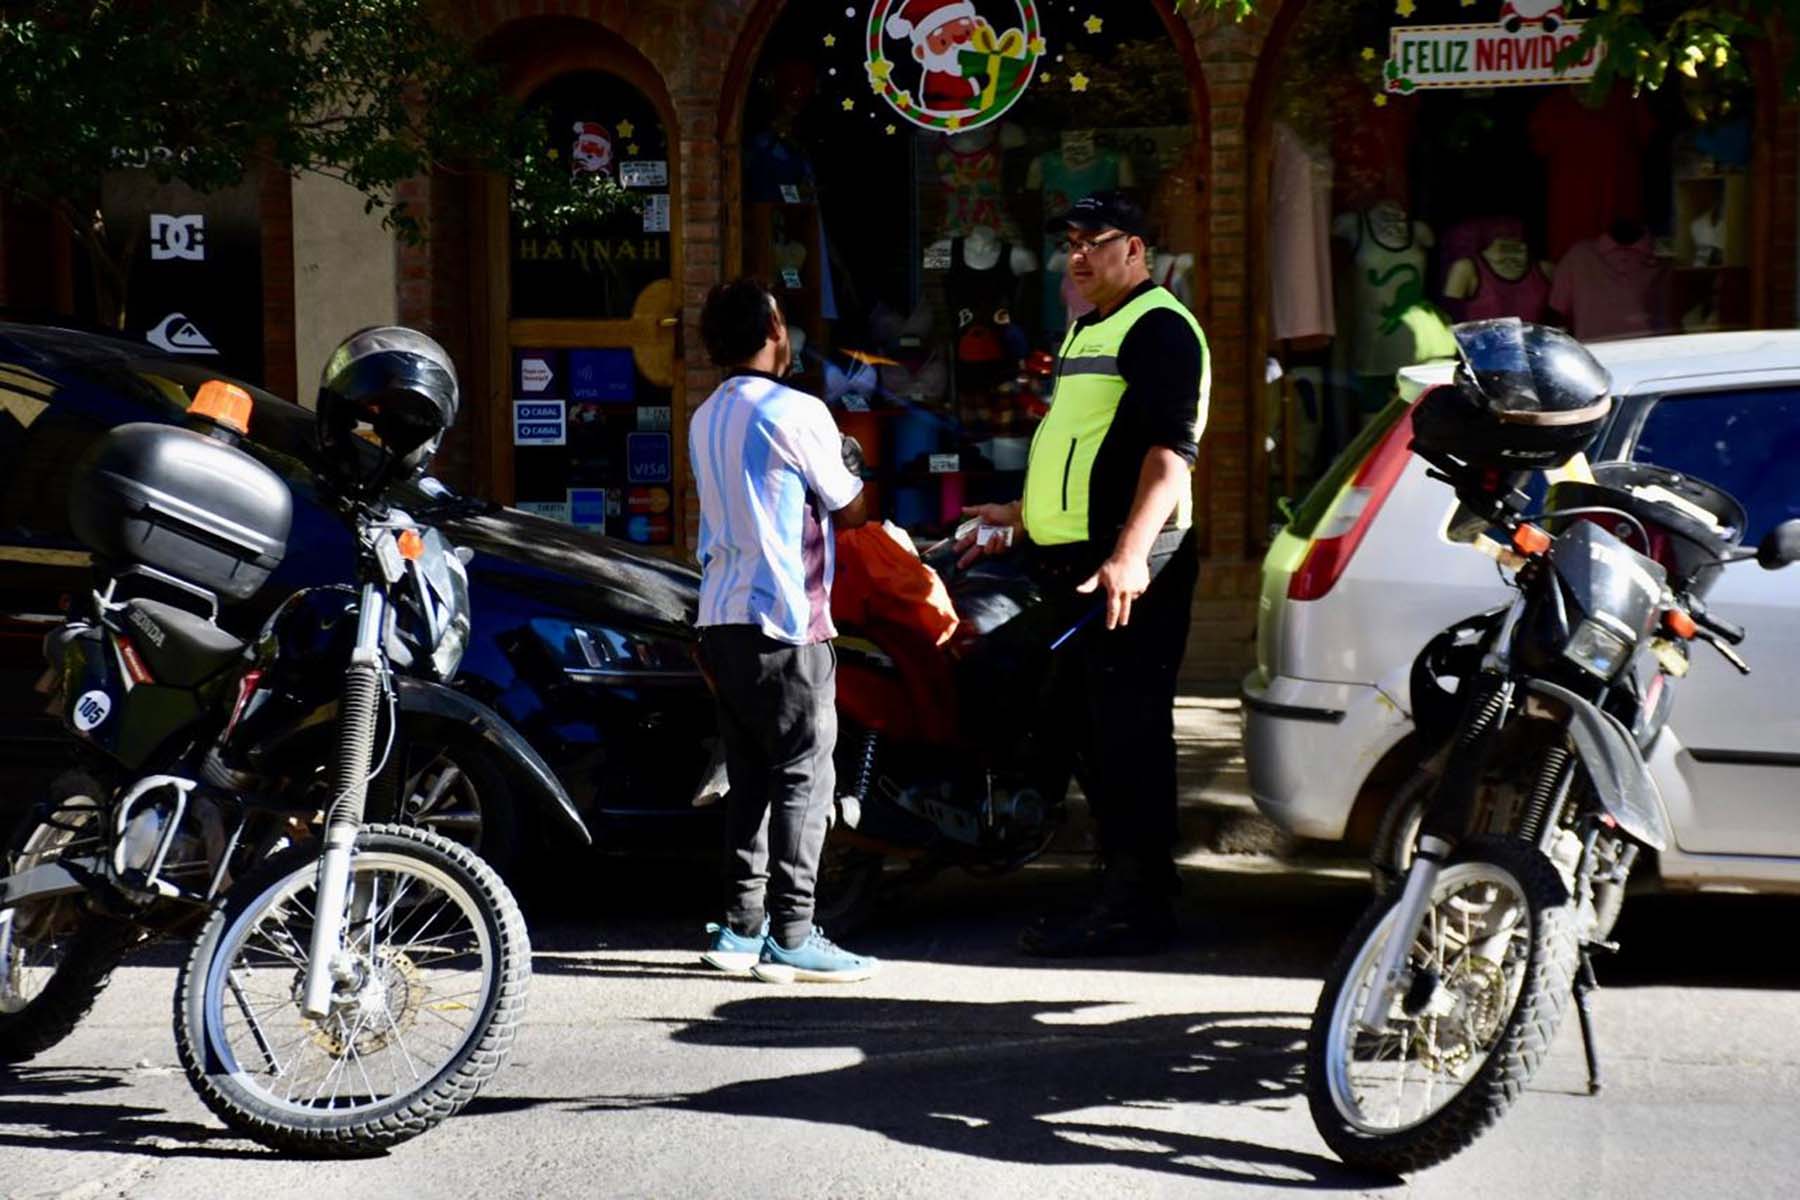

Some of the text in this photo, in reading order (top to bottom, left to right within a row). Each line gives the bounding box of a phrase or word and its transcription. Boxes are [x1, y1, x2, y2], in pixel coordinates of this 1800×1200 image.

[1402, 41, 1468, 73] FELIZ
[519, 238, 662, 270] HANNAH
[532, 407, 558, 416] CABAL
[532, 426, 559, 436] CABAL
[633, 463, 666, 477] VISA
[128, 608, 165, 648] HONDA
[78, 697, 105, 725] 105
